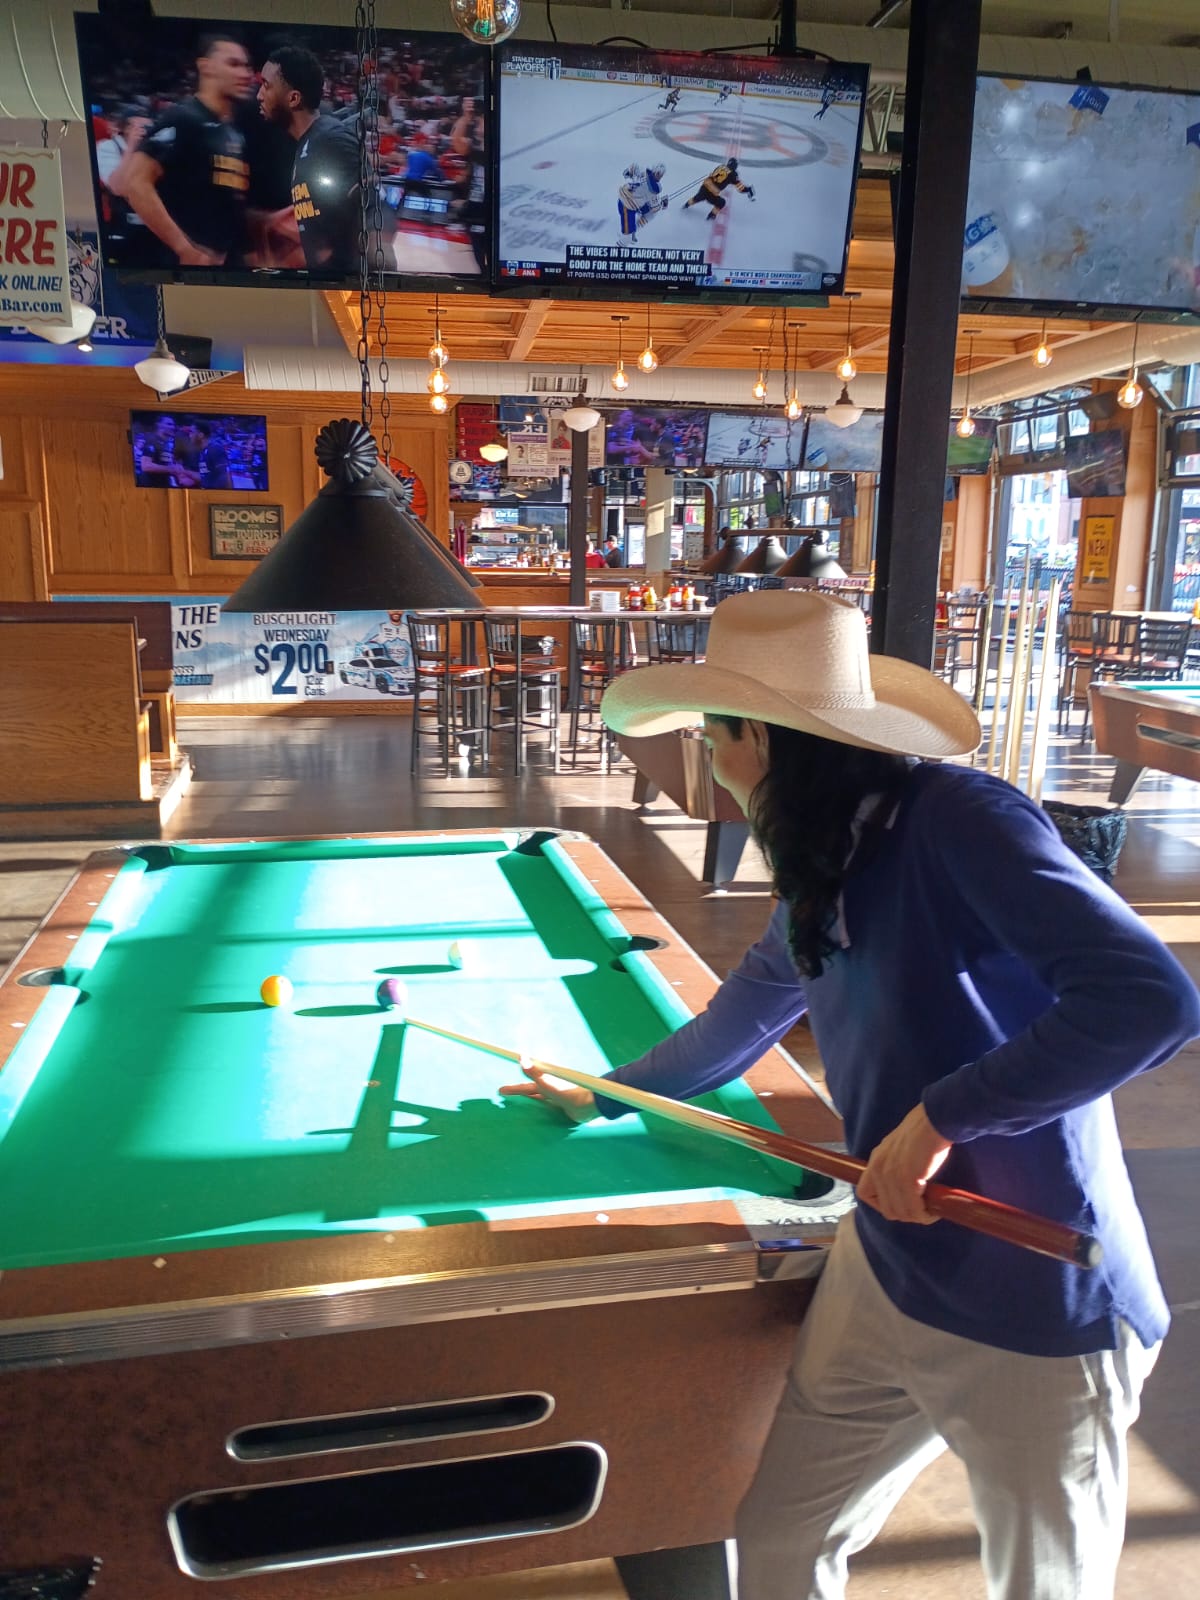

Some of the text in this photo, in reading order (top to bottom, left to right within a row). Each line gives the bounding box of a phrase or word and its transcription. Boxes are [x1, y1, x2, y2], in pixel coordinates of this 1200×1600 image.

[506, 62, 545, 71] PLAYOFFS
[0, 218, 57, 266] RE
[570, 246, 584, 256] THE
[586, 247, 608, 257] VIBES
[610, 248, 618, 257] IN
[666, 250, 680, 260] NOT
[682, 251, 701, 261] VERY
[569, 260, 708, 274] GOOD FOR THE HOME TEAM AND THEIR
[12, 277, 63, 292] ONLINE!
[0, 299, 63, 313] Bar.com
[214, 510, 279, 523] ROOMS
[179, 605, 218, 626] THE
[172, 629, 203, 649] NS
[264, 629, 330, 642] WEDNESDAY
